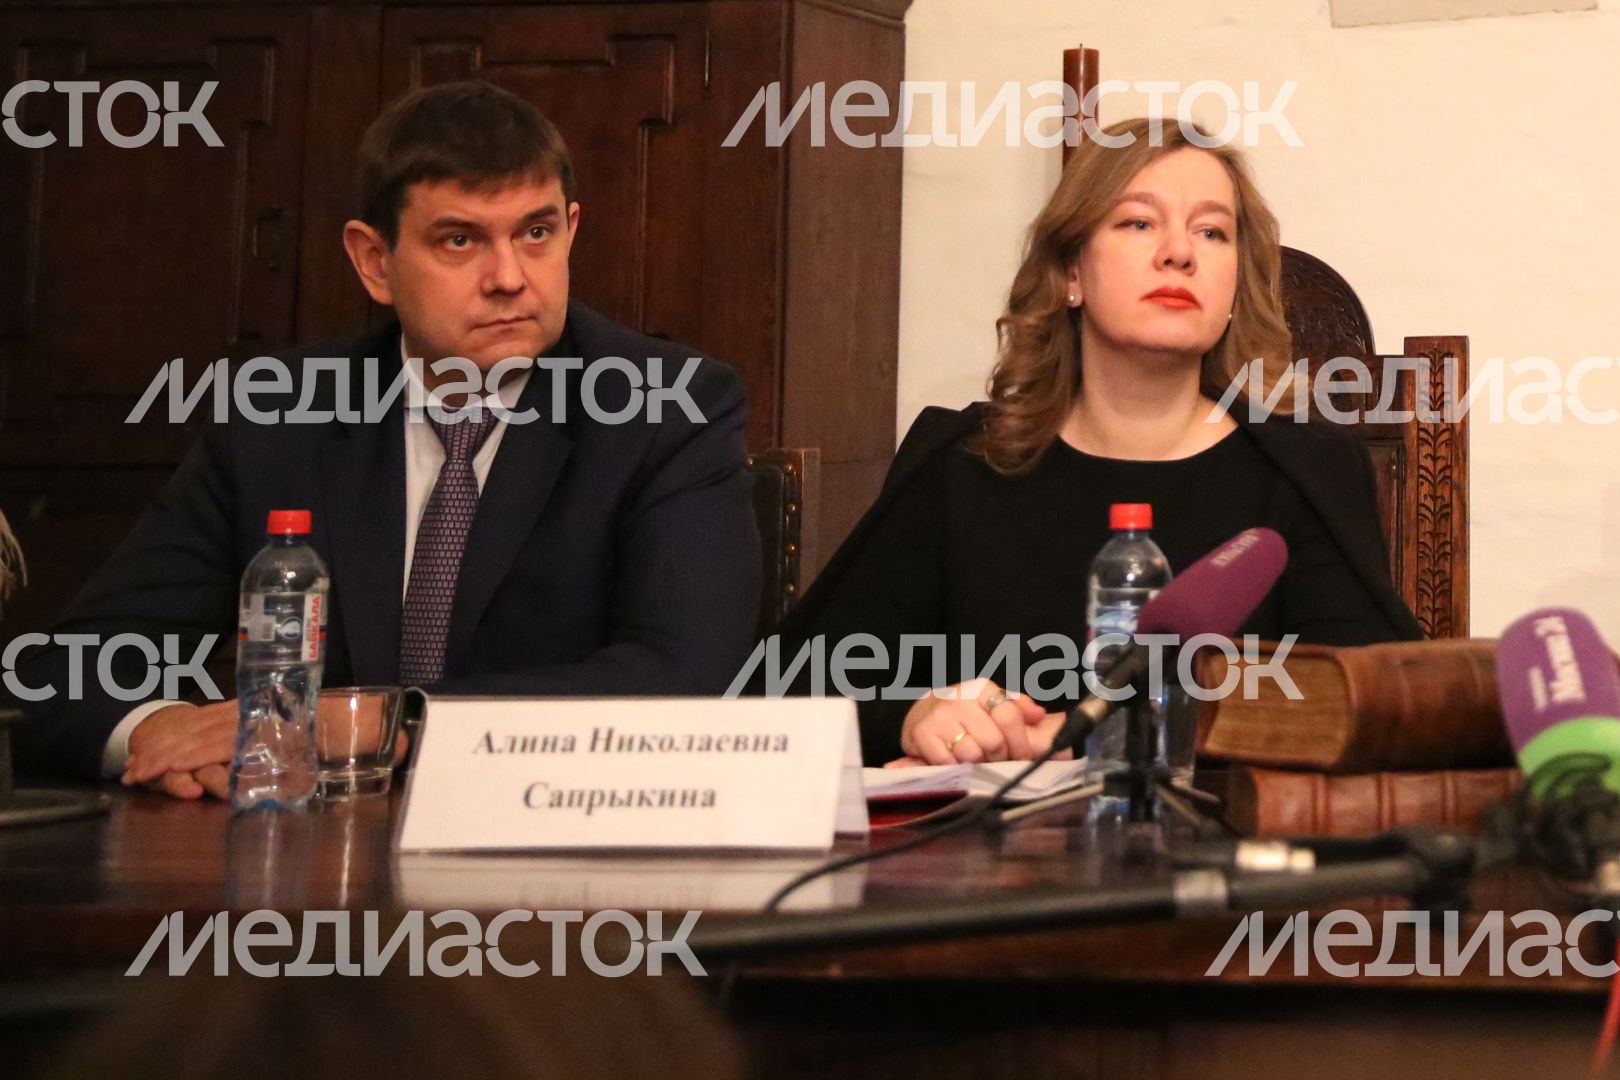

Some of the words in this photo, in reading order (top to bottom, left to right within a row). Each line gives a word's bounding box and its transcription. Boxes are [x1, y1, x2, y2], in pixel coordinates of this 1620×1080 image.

[472, 729, 578, 756] Алина
[587, 725, 790, 754] Николаевна
[522, 780, 718, 817] Сапрыкина
